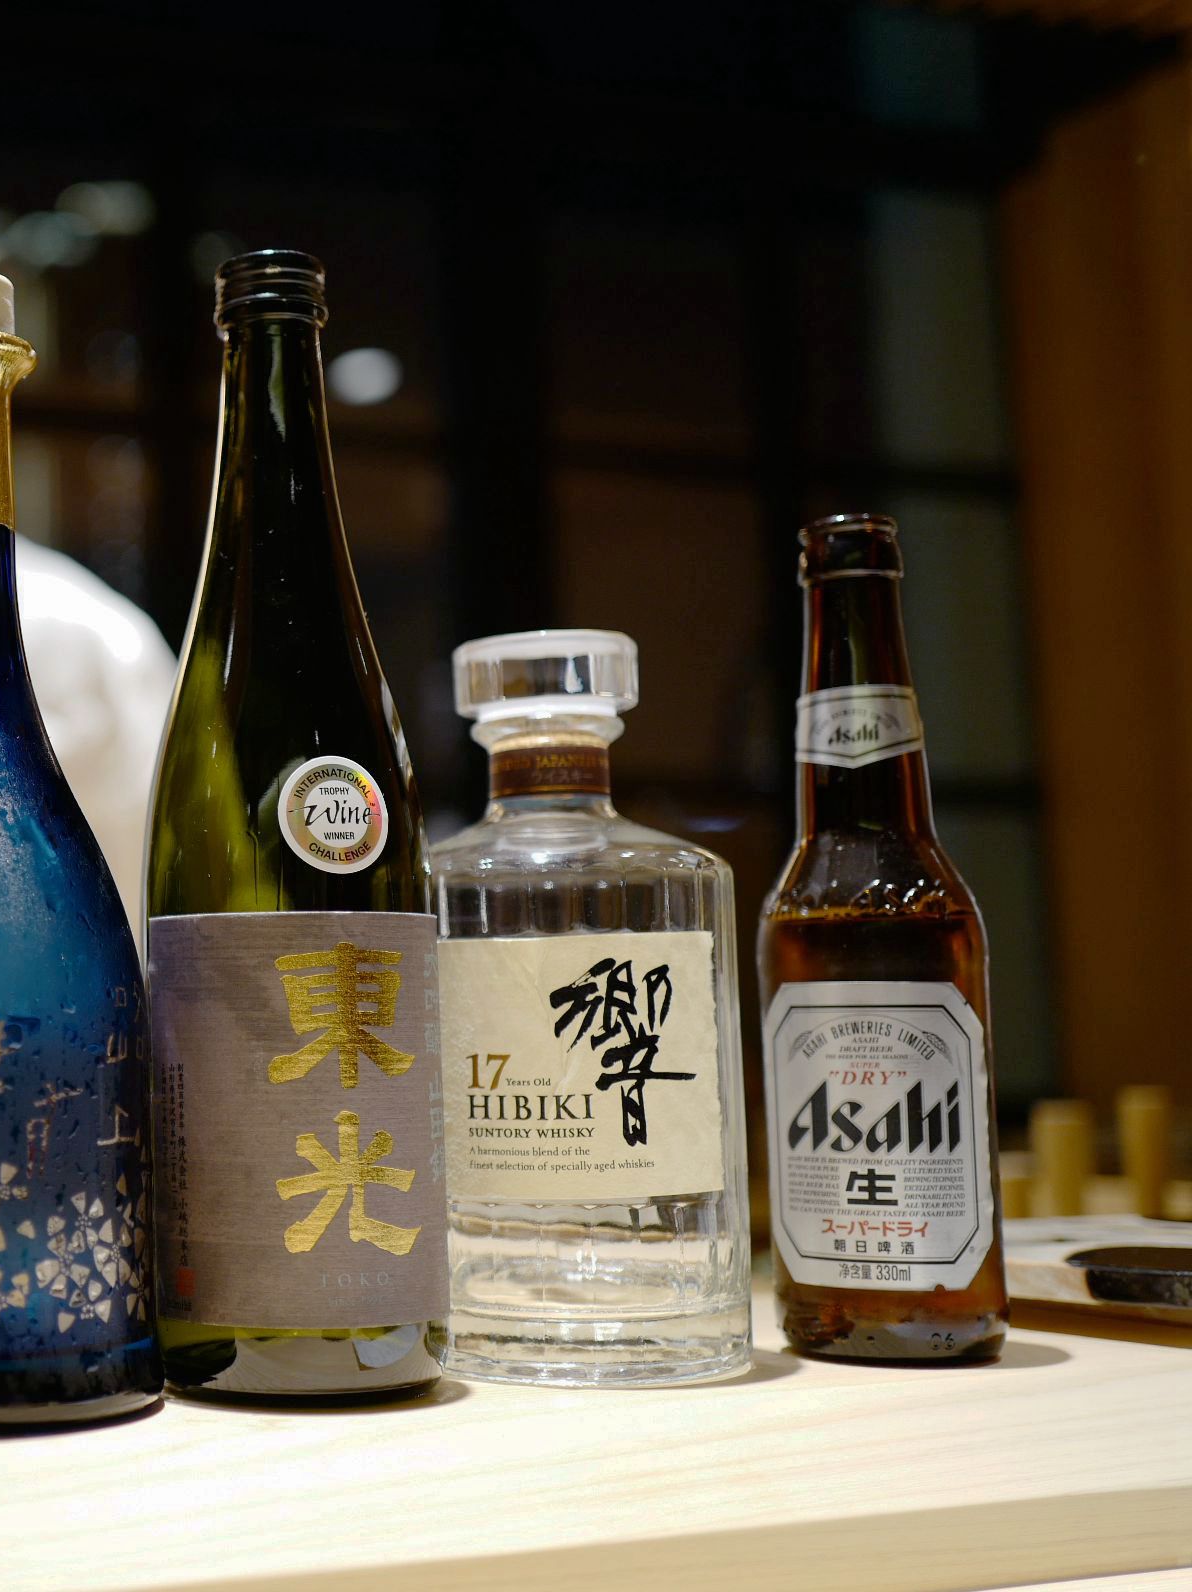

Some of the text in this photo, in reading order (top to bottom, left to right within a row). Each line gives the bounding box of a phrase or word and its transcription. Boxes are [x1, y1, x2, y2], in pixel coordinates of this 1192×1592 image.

[828, 723, 879, 745] Asahi
[293, 768, 370, 799] INTERNATIONAL
[319, 787, 350, 795] TROPHY
[288, 800, 380, 826] Wine
[324, 832, 355, 840] WINNER
[309, 841, 372, 861] CHALLENGE
[802, 1021, 936, 1061] ASAHI BREWERIES LIMITED
[465, 1053, 551, 1091] 17 Years Old
[267, 941, 422, 1256] 東光
[466, 1093, 595, 1121] HIBIKI
[787, 1080, 960, 1154] Asahi
[468, 1127, 595, 1138] SUNTORY WHISKY
[477, 1147, 530, 1157] harmonious
[532, 1147, 559, 1156] blend
[561, 1146, 573, 1156] of
[575, 1147, 590, 1156] the
[469, 1159, 655, 1173] finest selection of specially aged whiskies
[884, 1159, 916, 1167] QUALITY
[845, 1168, 899, 1206] 生
[821, 1219, 929, 1238] スーパードライ
[834, 1239, 915, 1255] 朝日啤酒
[320, 1271, 391, 1288] TOKO
[876, 1264, 912, 1281] 330ml
